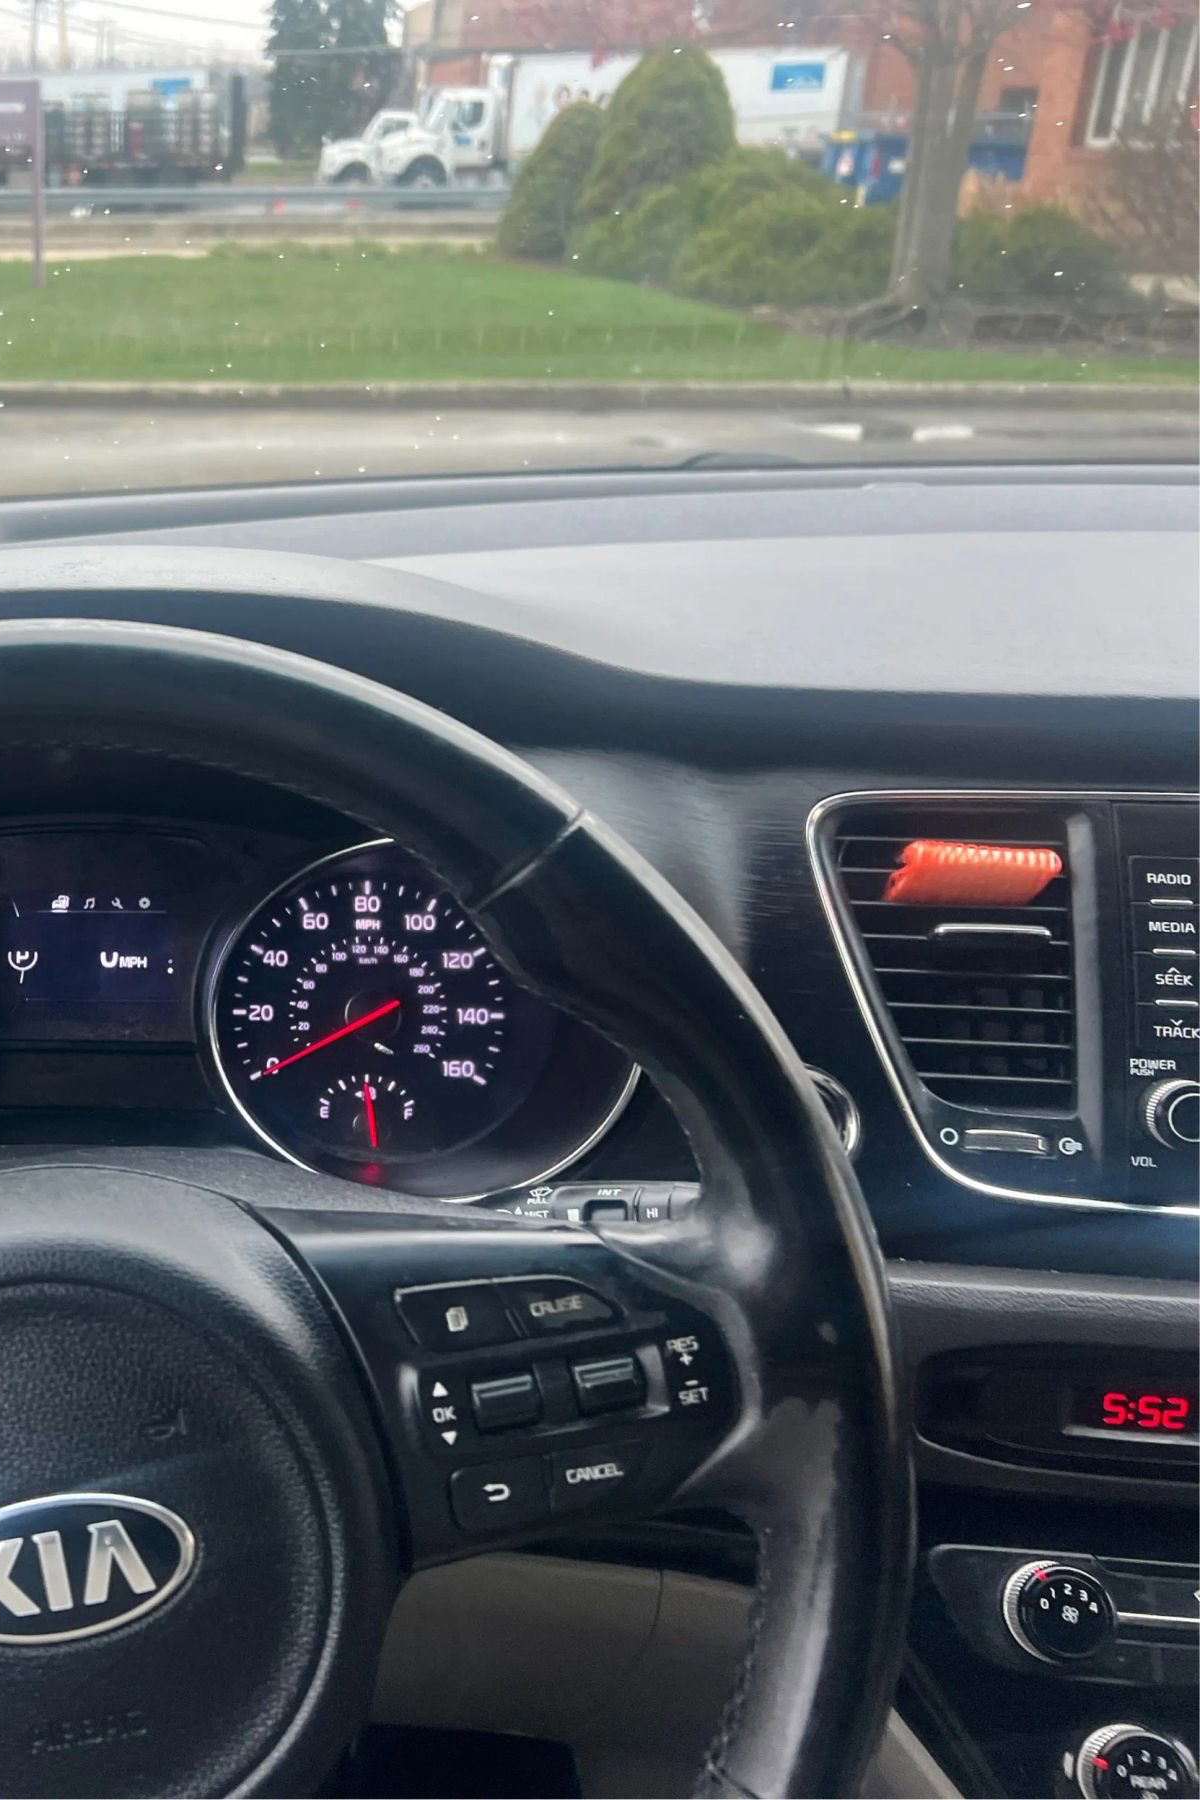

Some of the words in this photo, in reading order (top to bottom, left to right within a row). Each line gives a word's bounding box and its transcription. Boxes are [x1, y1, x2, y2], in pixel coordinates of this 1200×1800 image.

[1146, 872, 1191, 886] RADIO
[354, 895, 381, 913] 80
[302, 912, 329, 930] 60
[355, 919, 380, 931] MPH
[404, 913, 436, 931] 100
[1148, 921, 1196, 934] MEDIA
[351, 944, 367, 954] 120
[373, 945, 389, 955] 140
[119, 955, 148, 968] MPH
[263, 952, 288, 967] 40
[331, 951, 347, 962] 100
[393, 953, 409, 964] 160
[442, 951, 474, 970] 120
[315, 963, 328, 974] 80
[409, 967, 425, 978] 180
[303, 979, 316, 991] 60
[1155, 972, 1192, 986] SEEK
[417, 983, 436, 994] 200
[297, 1000, 309, 1010] 40
[423, 1005, 441, 1014] 220
[249, 1004, 274, 1022] 20
[456, 1007, 489, 1025] 140
[298, 1021, 310, 1031] 20
[421, 1025, 439, 1034] 240
[1153, 1024, 1200, 1039] TRACK
[266, 1057, 280, 1075] 0
[442, 1060, 475, 1077] 160
[1129, 1058, 1176, 1071] POWER
[1130, 1067, 1154, 1077] PUSH
[319, 1106, 330, 1119] E
[403, 1108, 414, 1120] F
[1130, 1156, 1158, 1168] VOL
[597, 1189, 622, 1197] INT
[646, 1208, 659, 1219] HI
[530, 1295, 584, 1317] CRUISE
[666, 1336, 699, 1351] RES
[678, 1387, 709, 1405] SET
[432, 1407, 456, 1423] OK
[1103, 1394, 1189, 1429] 5:52
[565, 1463, 624, 1484] CANCEL
[1040, 1598, 1049, 1610] 0
[1050, 1587, 1056, 1599] 1
[1064, 1583, 1073, 1595] 2
[1080, 1589, 1088, 1601] 3
[1089, 1602, 1098, 1614] 4
[1116, 1764, 1127, 1778] 0
[1141, 1749, 1151, 1763] 2
[1157, 1755, 1167, 1770] 3
